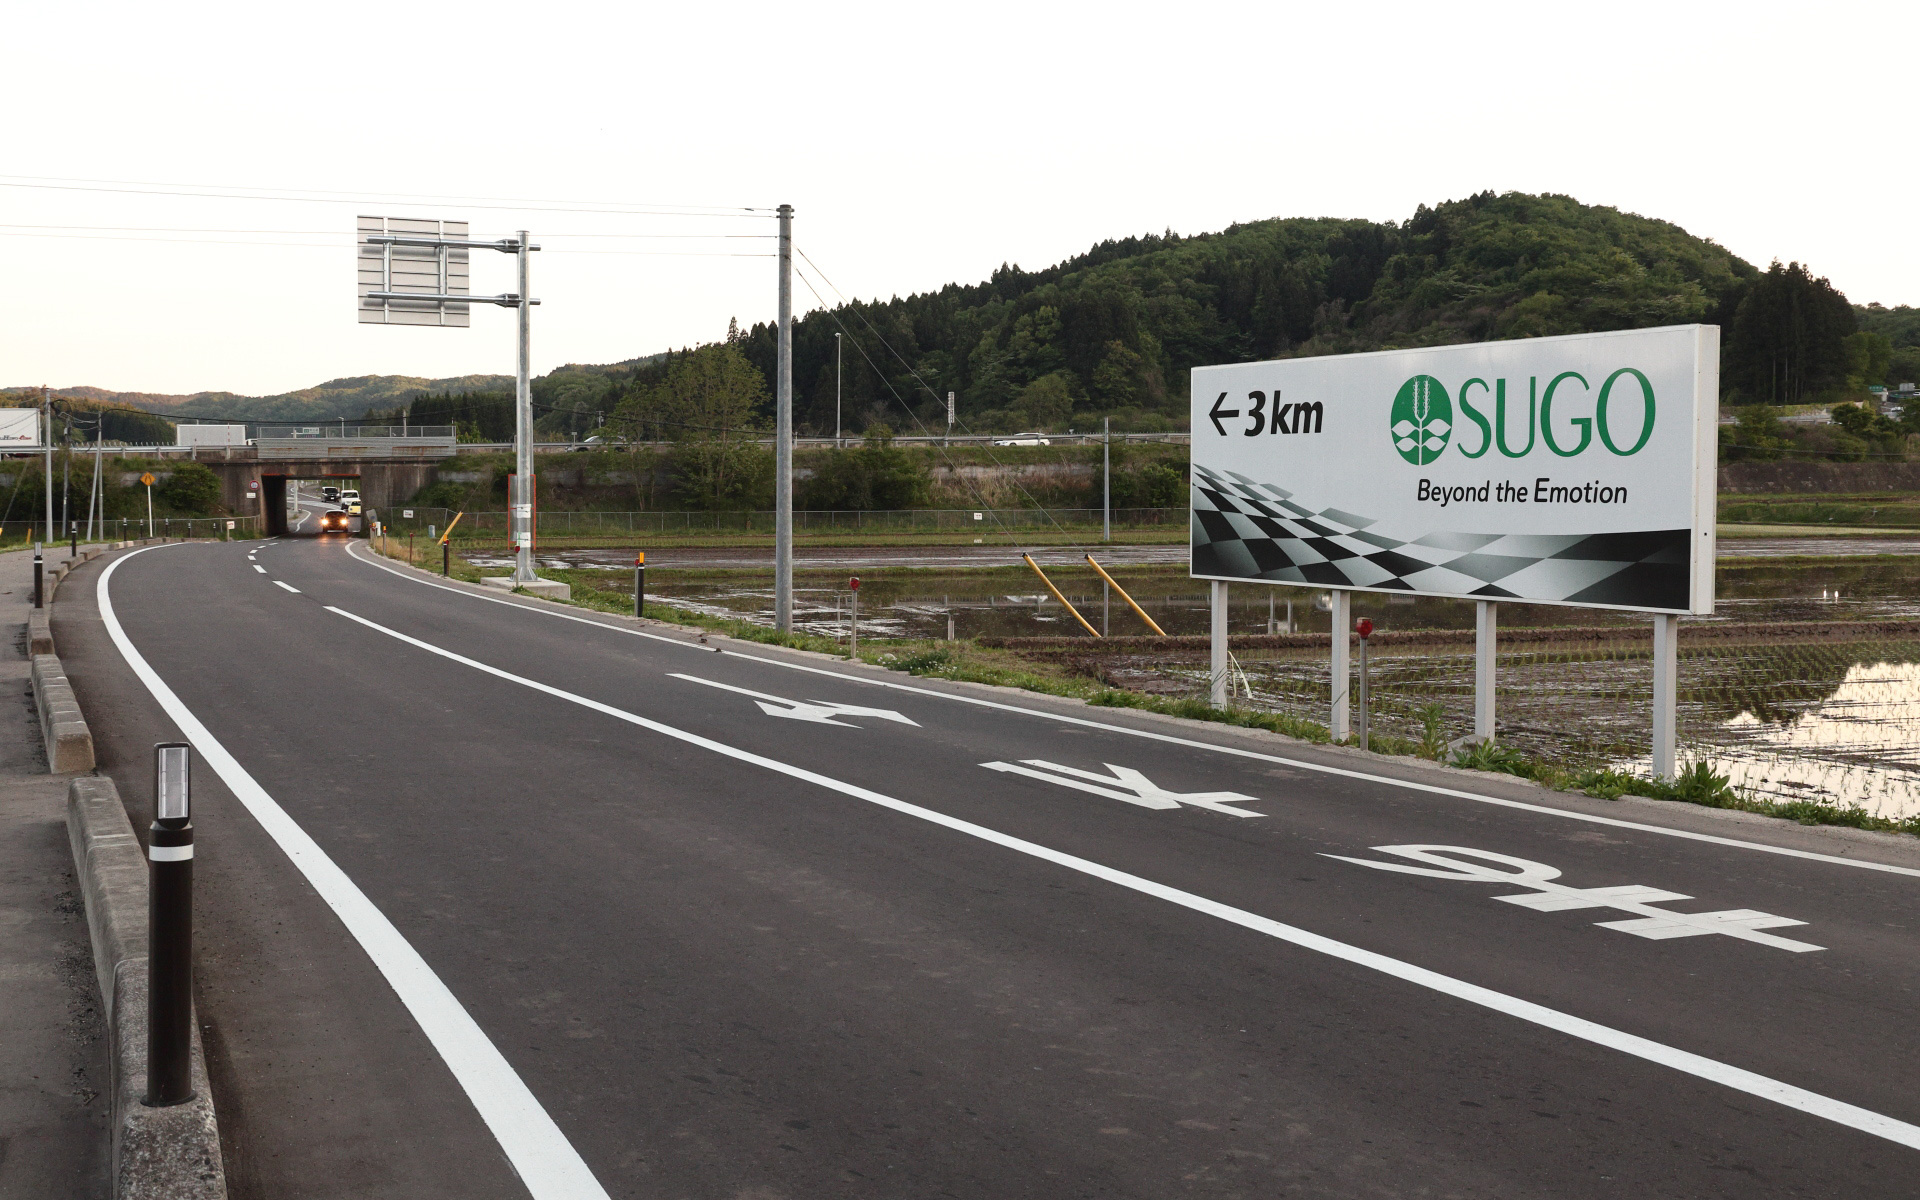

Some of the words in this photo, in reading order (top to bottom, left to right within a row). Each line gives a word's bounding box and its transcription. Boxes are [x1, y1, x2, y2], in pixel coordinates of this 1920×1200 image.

[1457, 367, 1657, 459] SUGO
[1417, 478, 1491, 508] Beyond
[1495, 479, 1529, 503] the
[1533, 477, 1628, 504] Emotion
